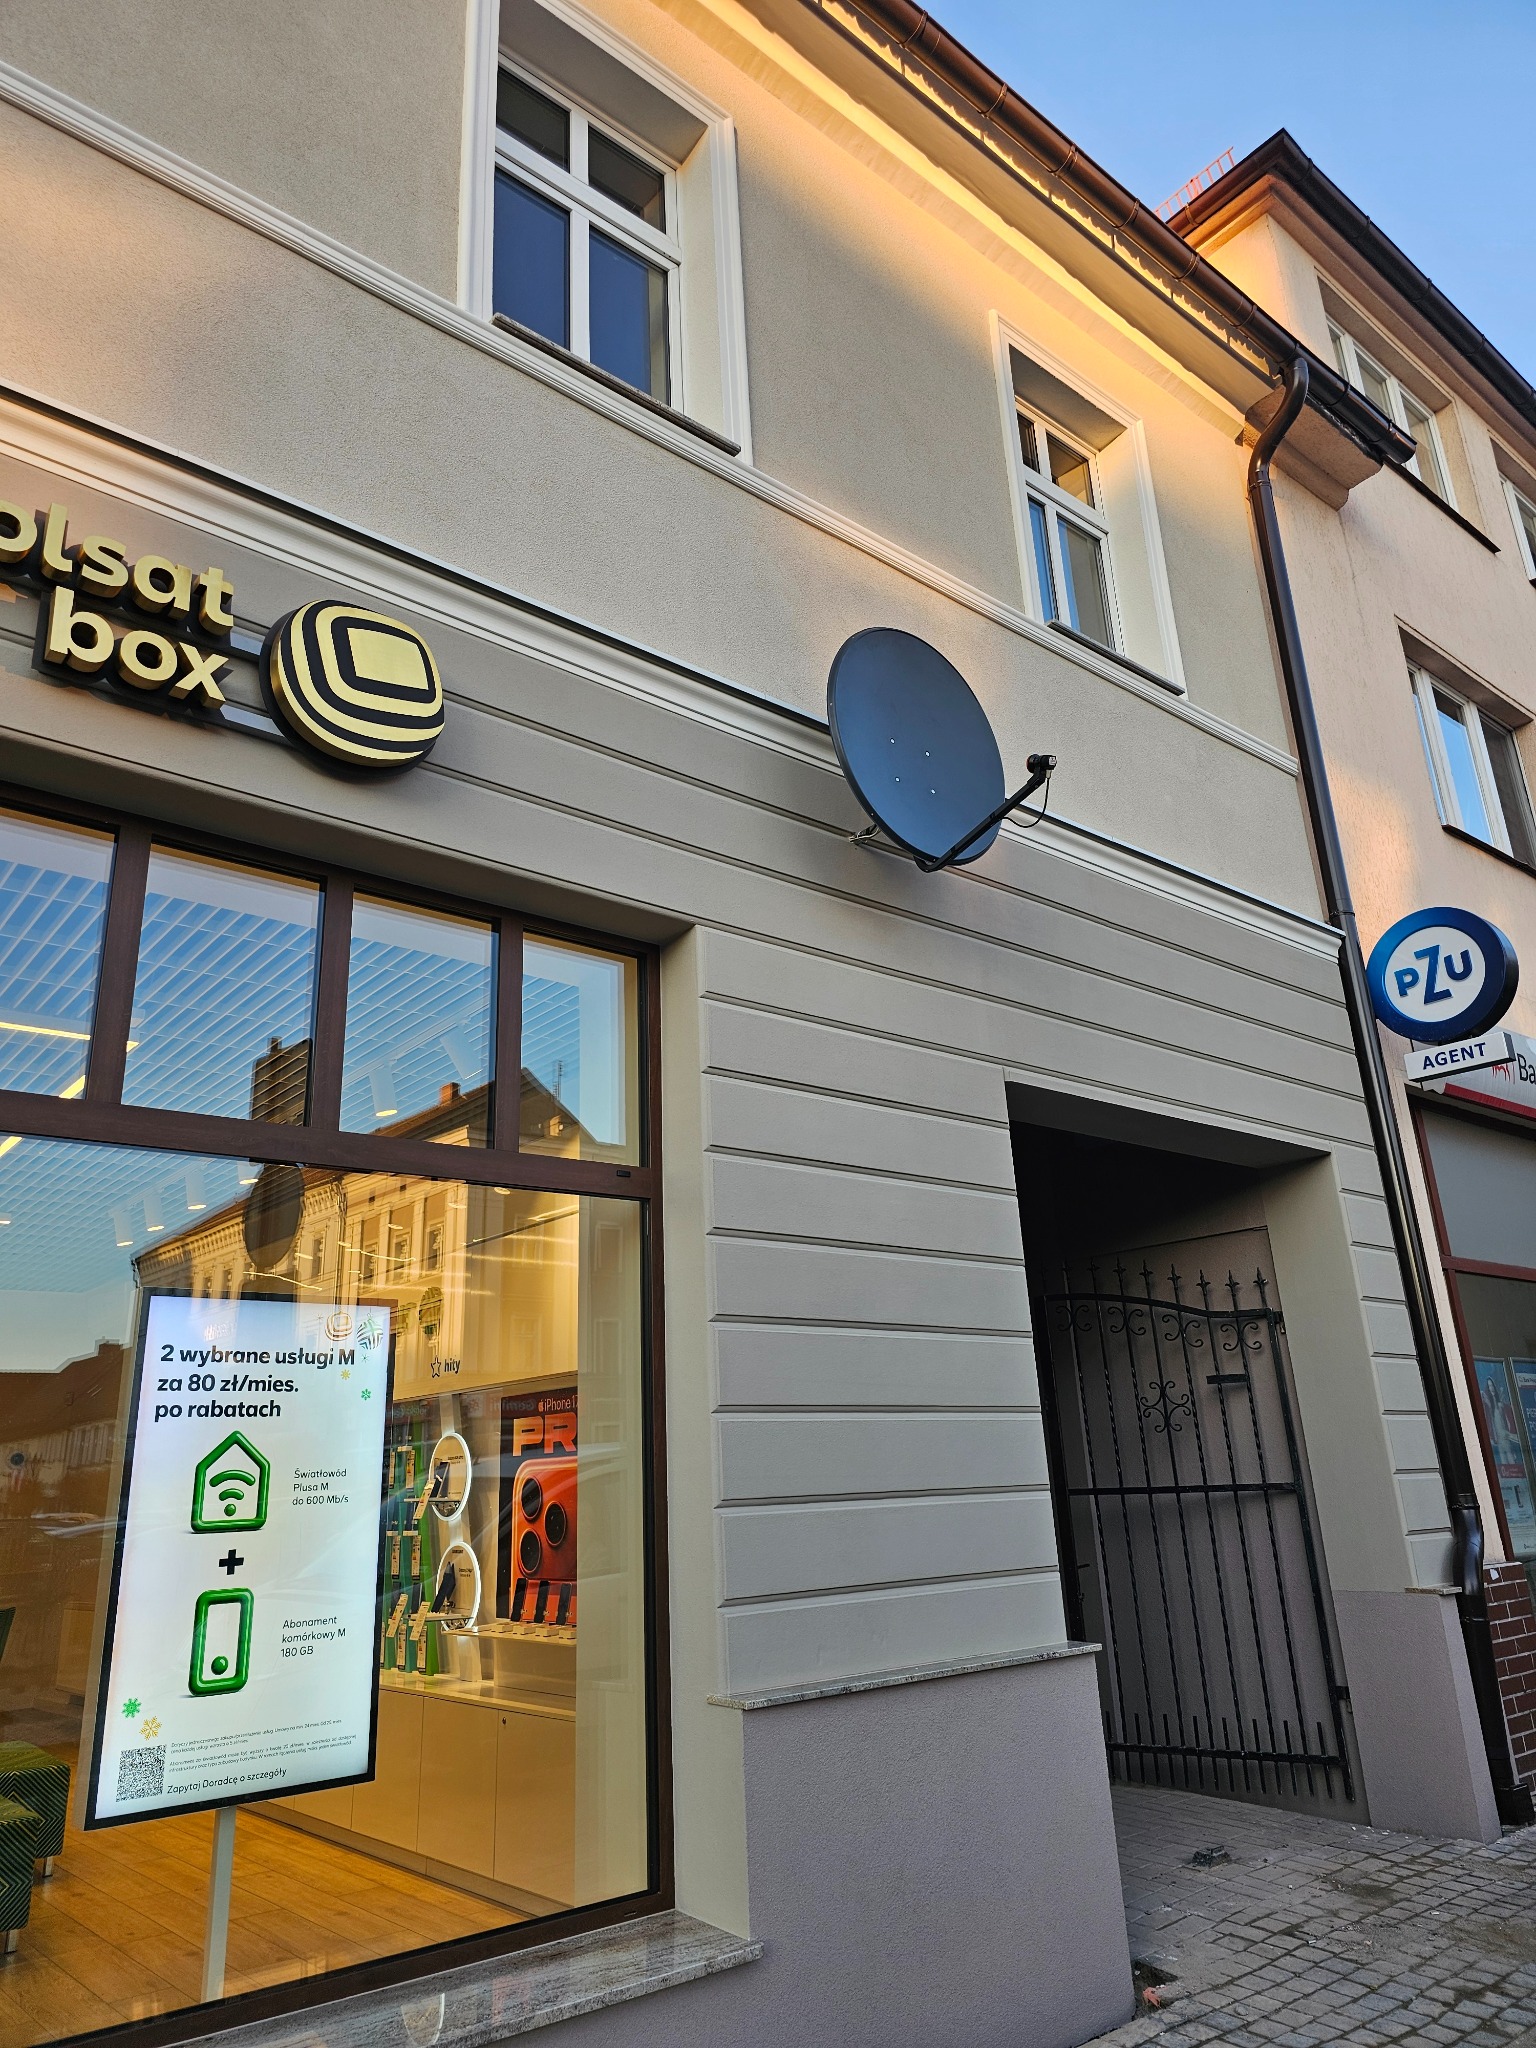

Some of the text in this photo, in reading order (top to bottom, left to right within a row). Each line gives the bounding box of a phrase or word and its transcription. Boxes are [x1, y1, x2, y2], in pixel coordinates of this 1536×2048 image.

[44, 586, 229, 709] box
[1394, 945, 1472, 1004] PZU
[1422, 1042, 1486, 1070] AGENT
[160, 1344, 355, 1369] 2 wybrane usługi M
[444, 1358, 461, 1374] hity
[157, 1374, 299, 1393] za 80 zł/mies.
[155, 1401, 281, 1422] po rabatach
[544, 1398, 571, 1412] iPhone
[513, 1412, 577, 1456] PR
[294, 1468, 347, 1479] Światłowód
[293, 1482, 329, 1492] Plusa M
[292, 1495, 349, 1506] do 600 Mb/s
[282, 1616, 338, 1629] Abonament
[281, 1628, 346, 1644] komórkowy M
[281, 1646, 314, 1658] 180 GB
[167, 1781, 201, 1794] Zapytaj
[202, 1776, 239, 1788] Doradcę
[247, 1768, 287, 1781] szczegóły
